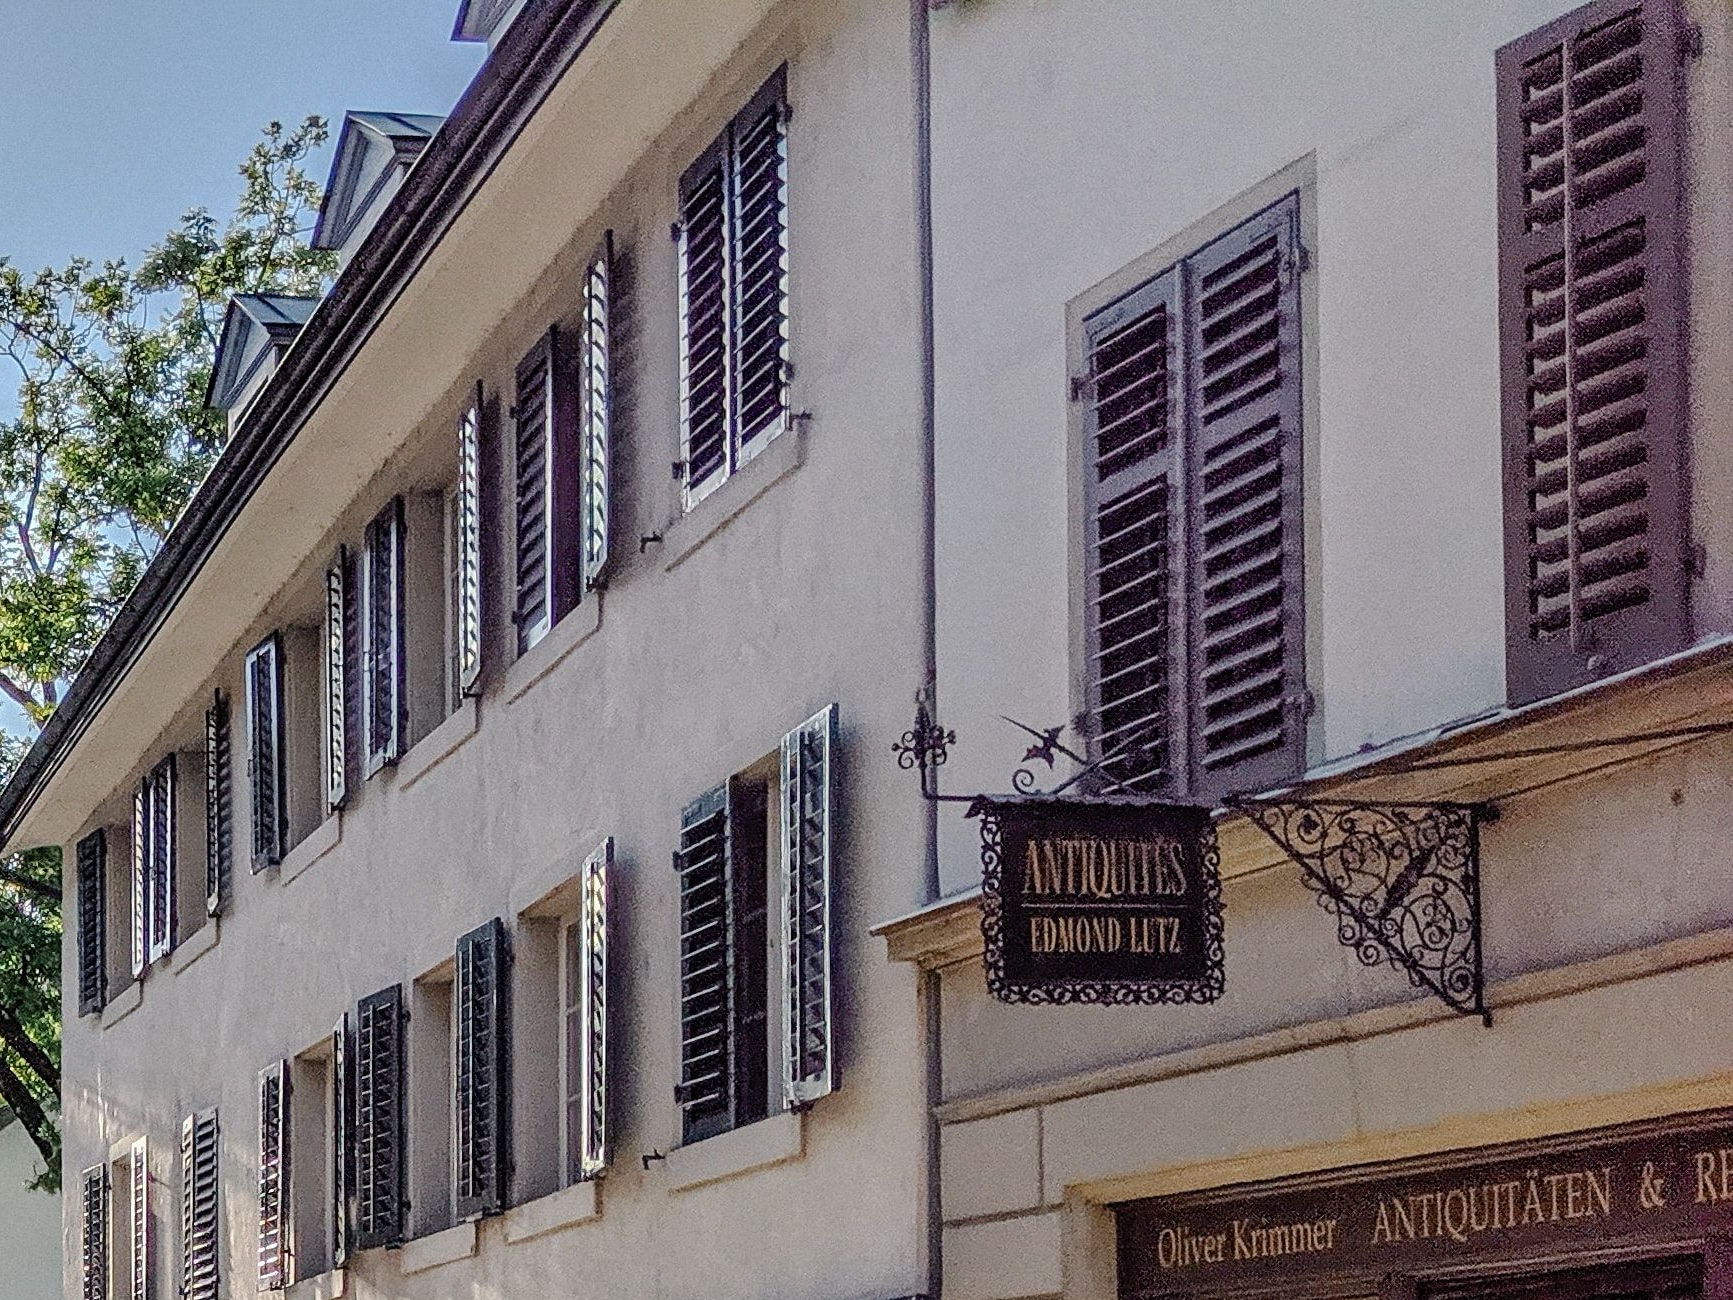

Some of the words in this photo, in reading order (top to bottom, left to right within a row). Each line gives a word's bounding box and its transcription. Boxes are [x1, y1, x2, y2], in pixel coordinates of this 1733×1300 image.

[1030, 917, 1121, 953] EDMOND
[1130, 917, 1181, 953] LUTZ
[1158, 1226, 1226, 1269] Oliver
[1233, 1218, 1337, 1260] Krimmer
[1371, 1167, 1613, 1244] ANTIQUITÄTEN
[1640, 1161, 1666, 1208] &
